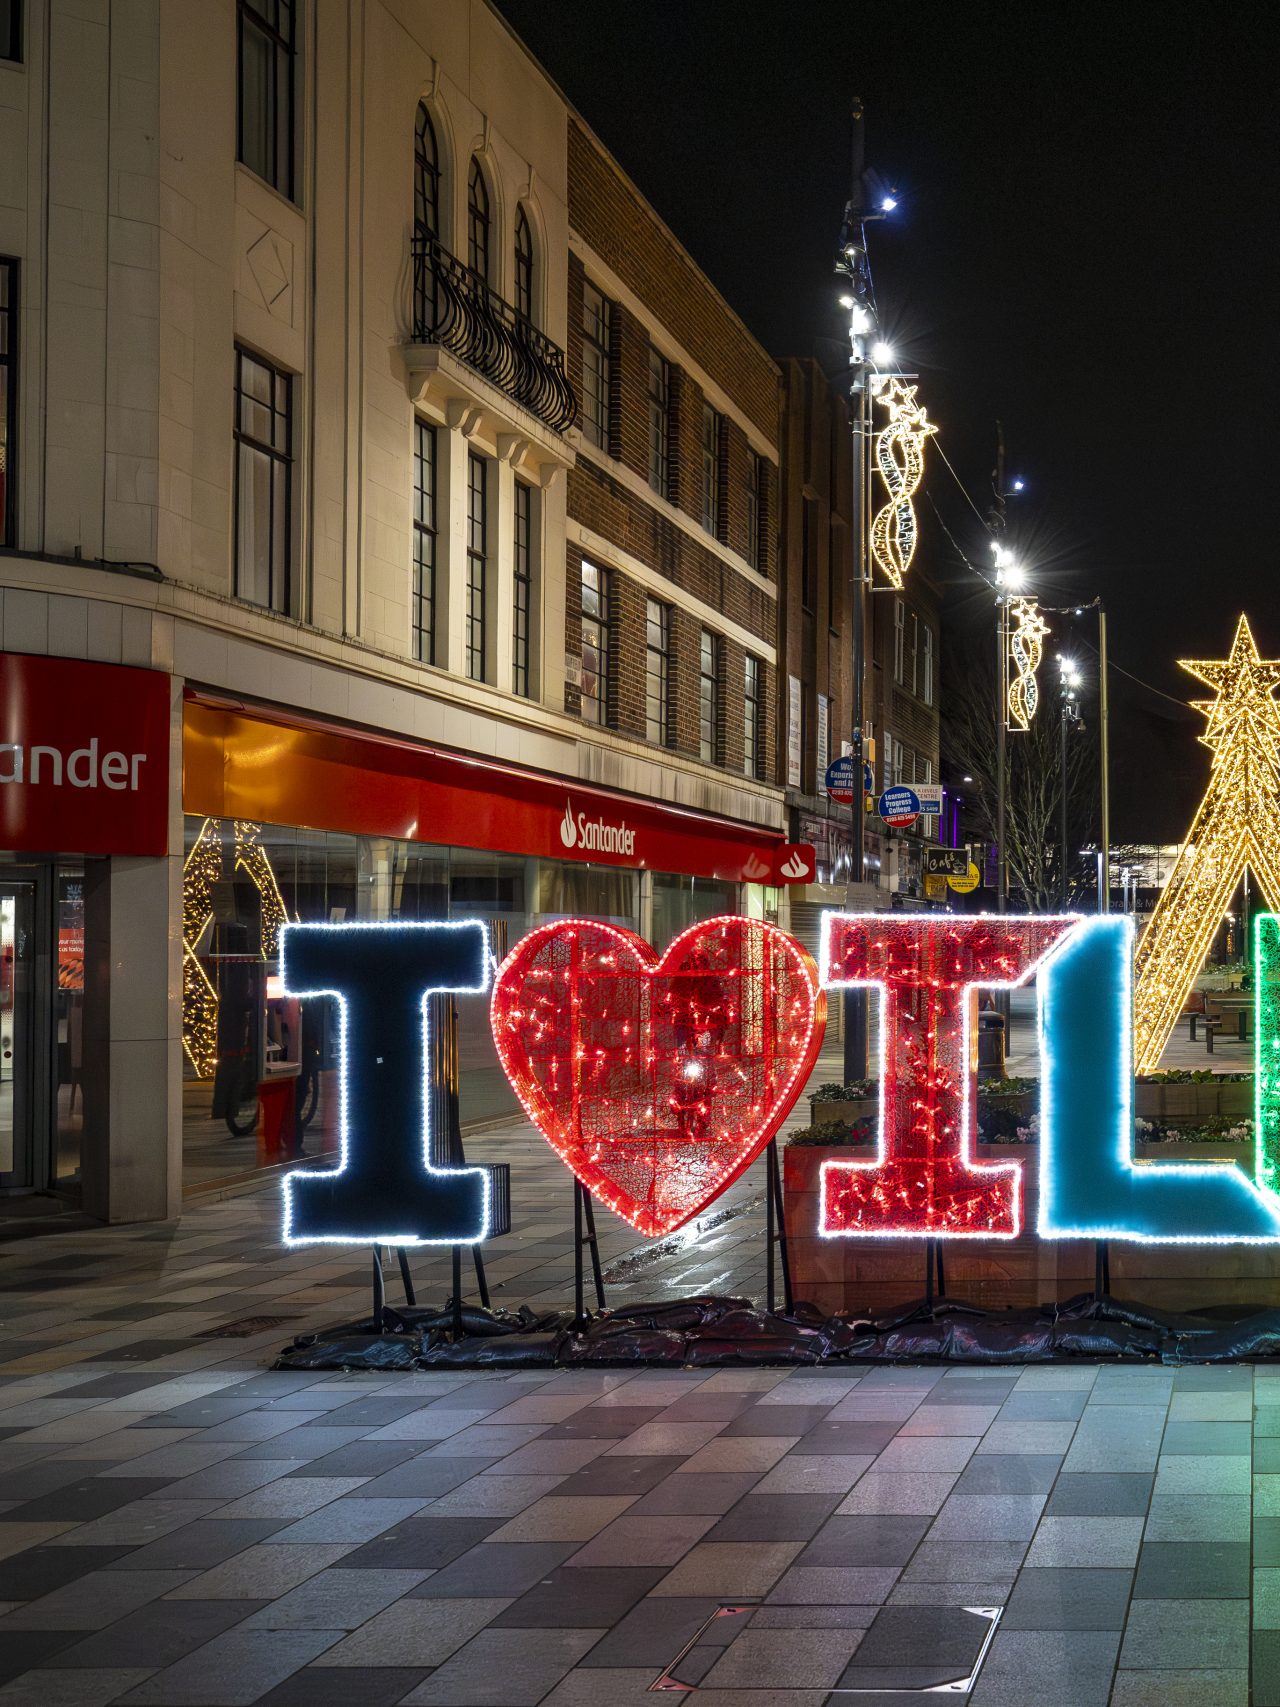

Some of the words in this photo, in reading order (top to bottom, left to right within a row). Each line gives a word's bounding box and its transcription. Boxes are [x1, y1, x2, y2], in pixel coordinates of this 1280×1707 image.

[885, 792, 911, 800] Learners
[885, 799, 912, 808] Progress
[889, 806, 911, 814] College
[578, 812, 636, 856] Santander
[278, 919, 491, 1246] I
